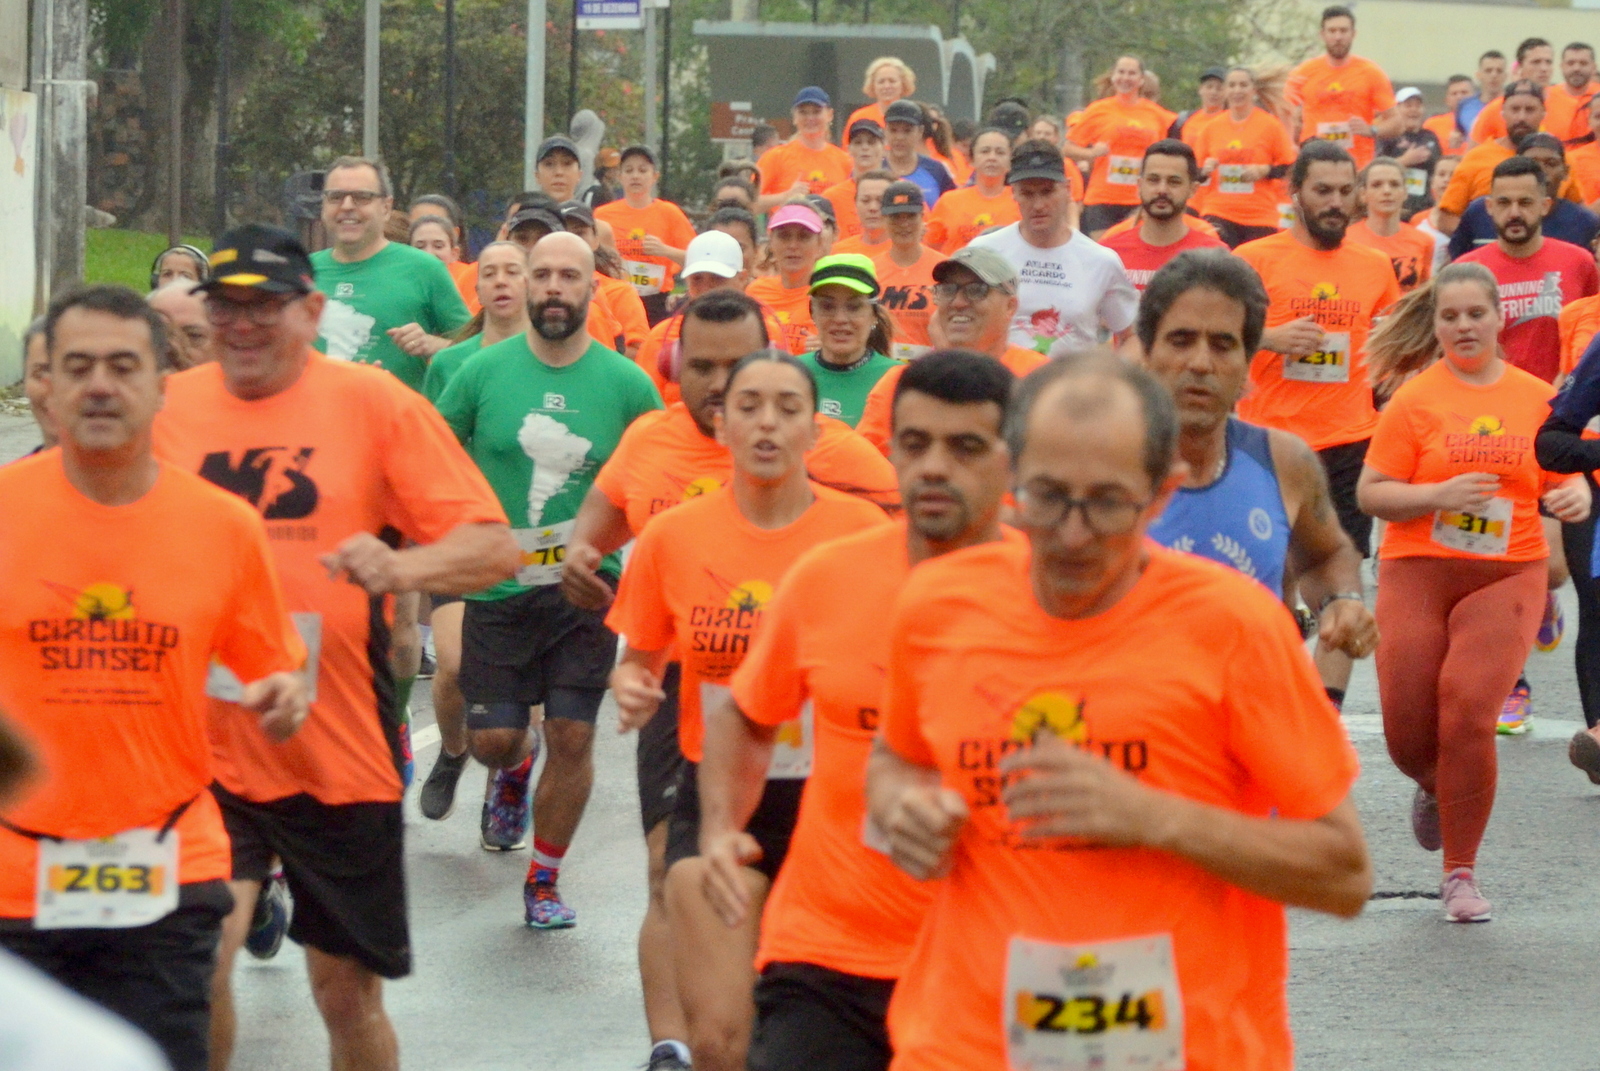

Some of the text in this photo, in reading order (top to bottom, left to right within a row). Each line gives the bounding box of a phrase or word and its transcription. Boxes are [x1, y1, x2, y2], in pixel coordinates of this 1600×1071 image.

[1020, 268, 1067, 280] RICARDO
[1025, 259, 1063, 270] ATLETA
[1497, 279, 1545, 299] UNNING
[1290, 297, 1361, 314] CIRCUITO
[1500, 295, 1562, 320] FRIENDS
[1445, 433, 1530, 450] CIRCUITO
[1449, 448, 1525, 465] SUNSET
[1458, 511, 1489, 535] 31
[28, 617, 180, 650] CIRCUITO
[40, 646, 167, 673] SUNSET
[63, 862, 153, 894] 263
[1033, 990, 1154, 1035] 234
